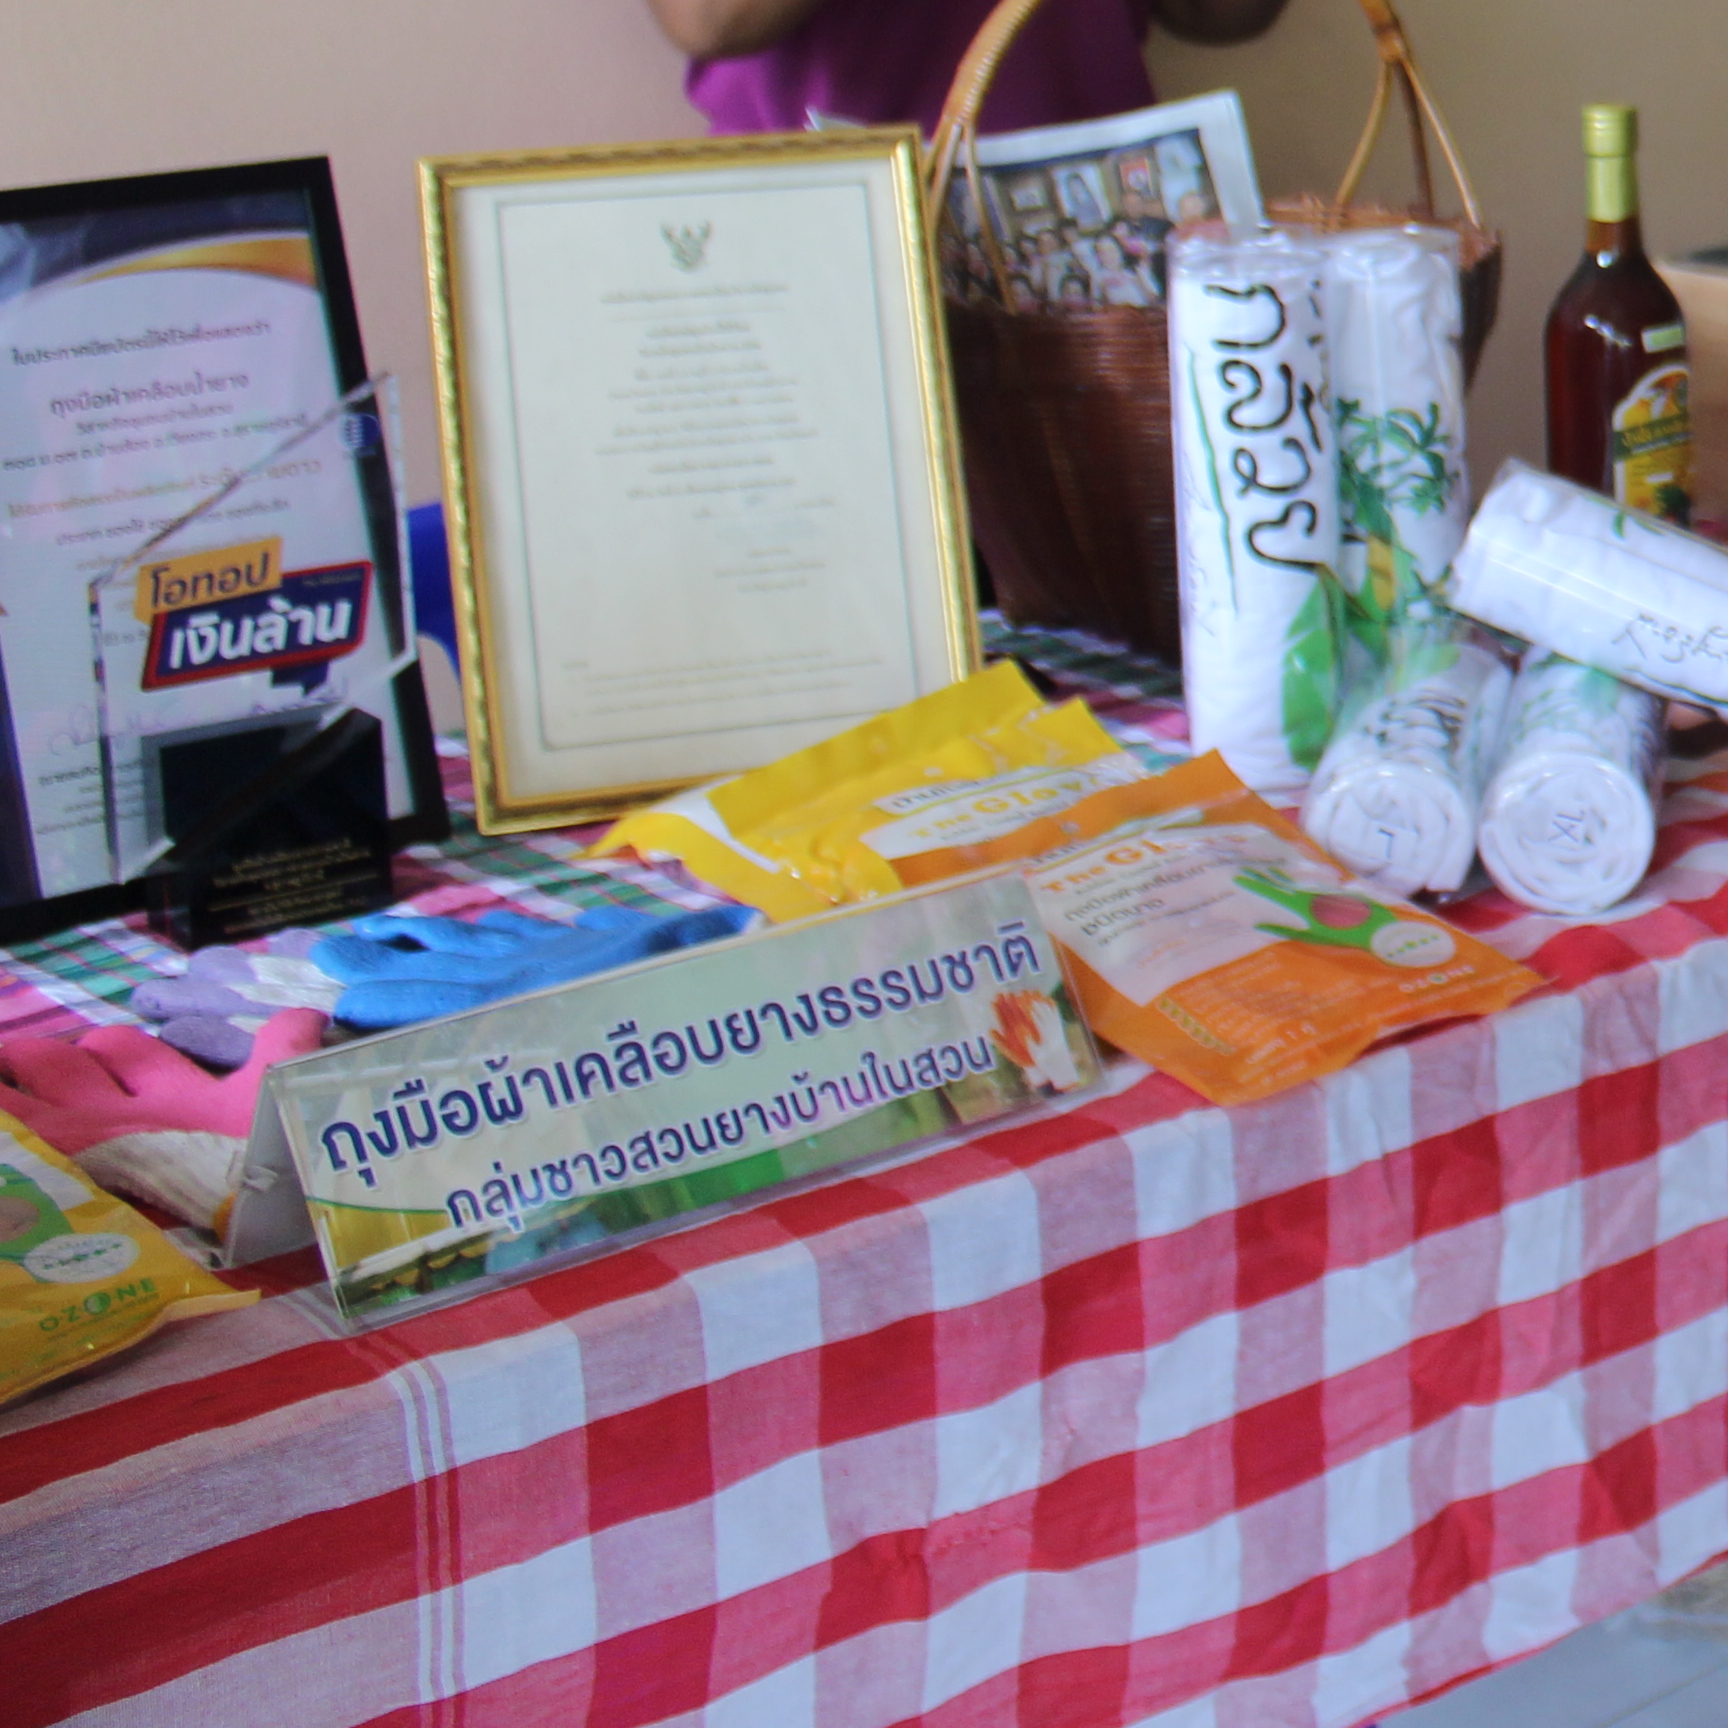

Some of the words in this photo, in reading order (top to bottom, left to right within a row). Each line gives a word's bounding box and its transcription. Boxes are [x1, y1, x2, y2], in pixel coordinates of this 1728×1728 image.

[149, 550, 272, 610] โอทอป
[168, 594, 353, 671] เงินล้าน
[319, 919, 1043, 1188] ถุงมือผ้าเคลือบยางธรรมชาติ
[444, 1031, 996, 1235] กลุ่มชาวสวนยางบ้านในสวน
